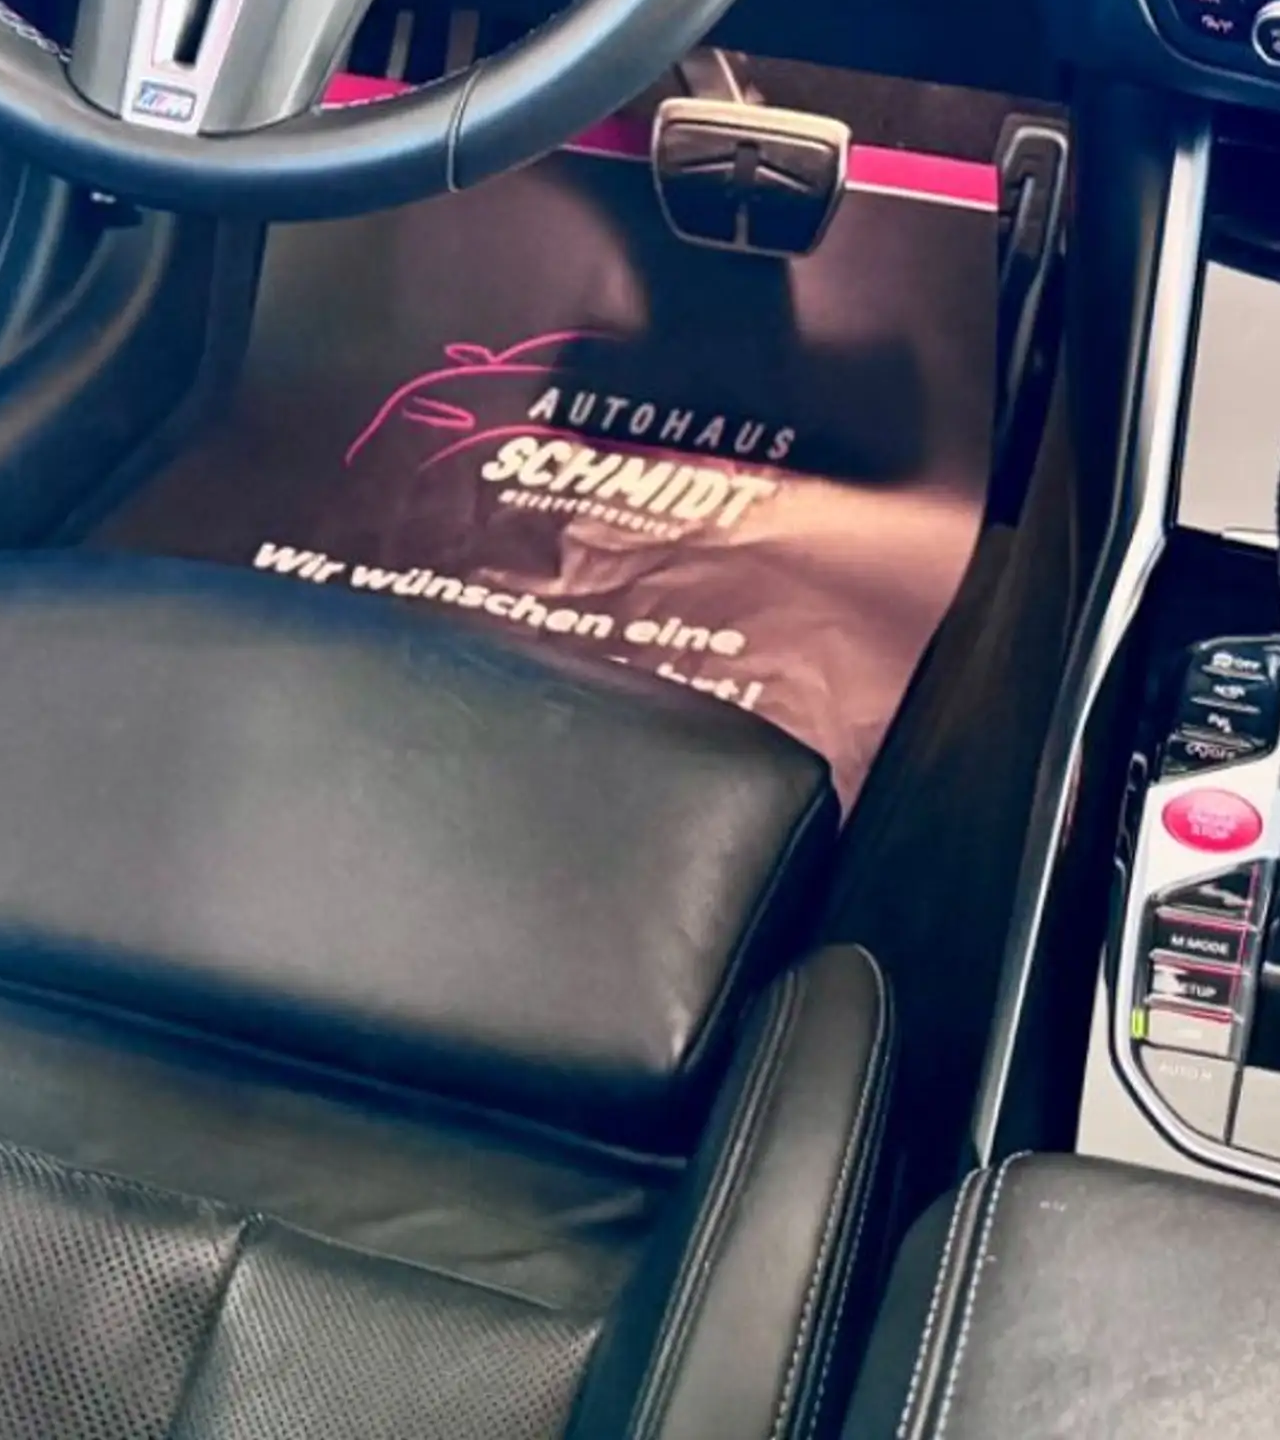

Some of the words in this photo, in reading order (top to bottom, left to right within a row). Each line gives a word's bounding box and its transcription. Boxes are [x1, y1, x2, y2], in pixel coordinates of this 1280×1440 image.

[528, 386, 798, 460] AUTOHAUS
[481, 435, 778, 529] SCHMIDT
[253, 541, 340, 585] Wir
[349, 564, 615, 642] wünschen
[624, 617, 746, 657] eine
[1187, 937, 1231, 956] MODE
